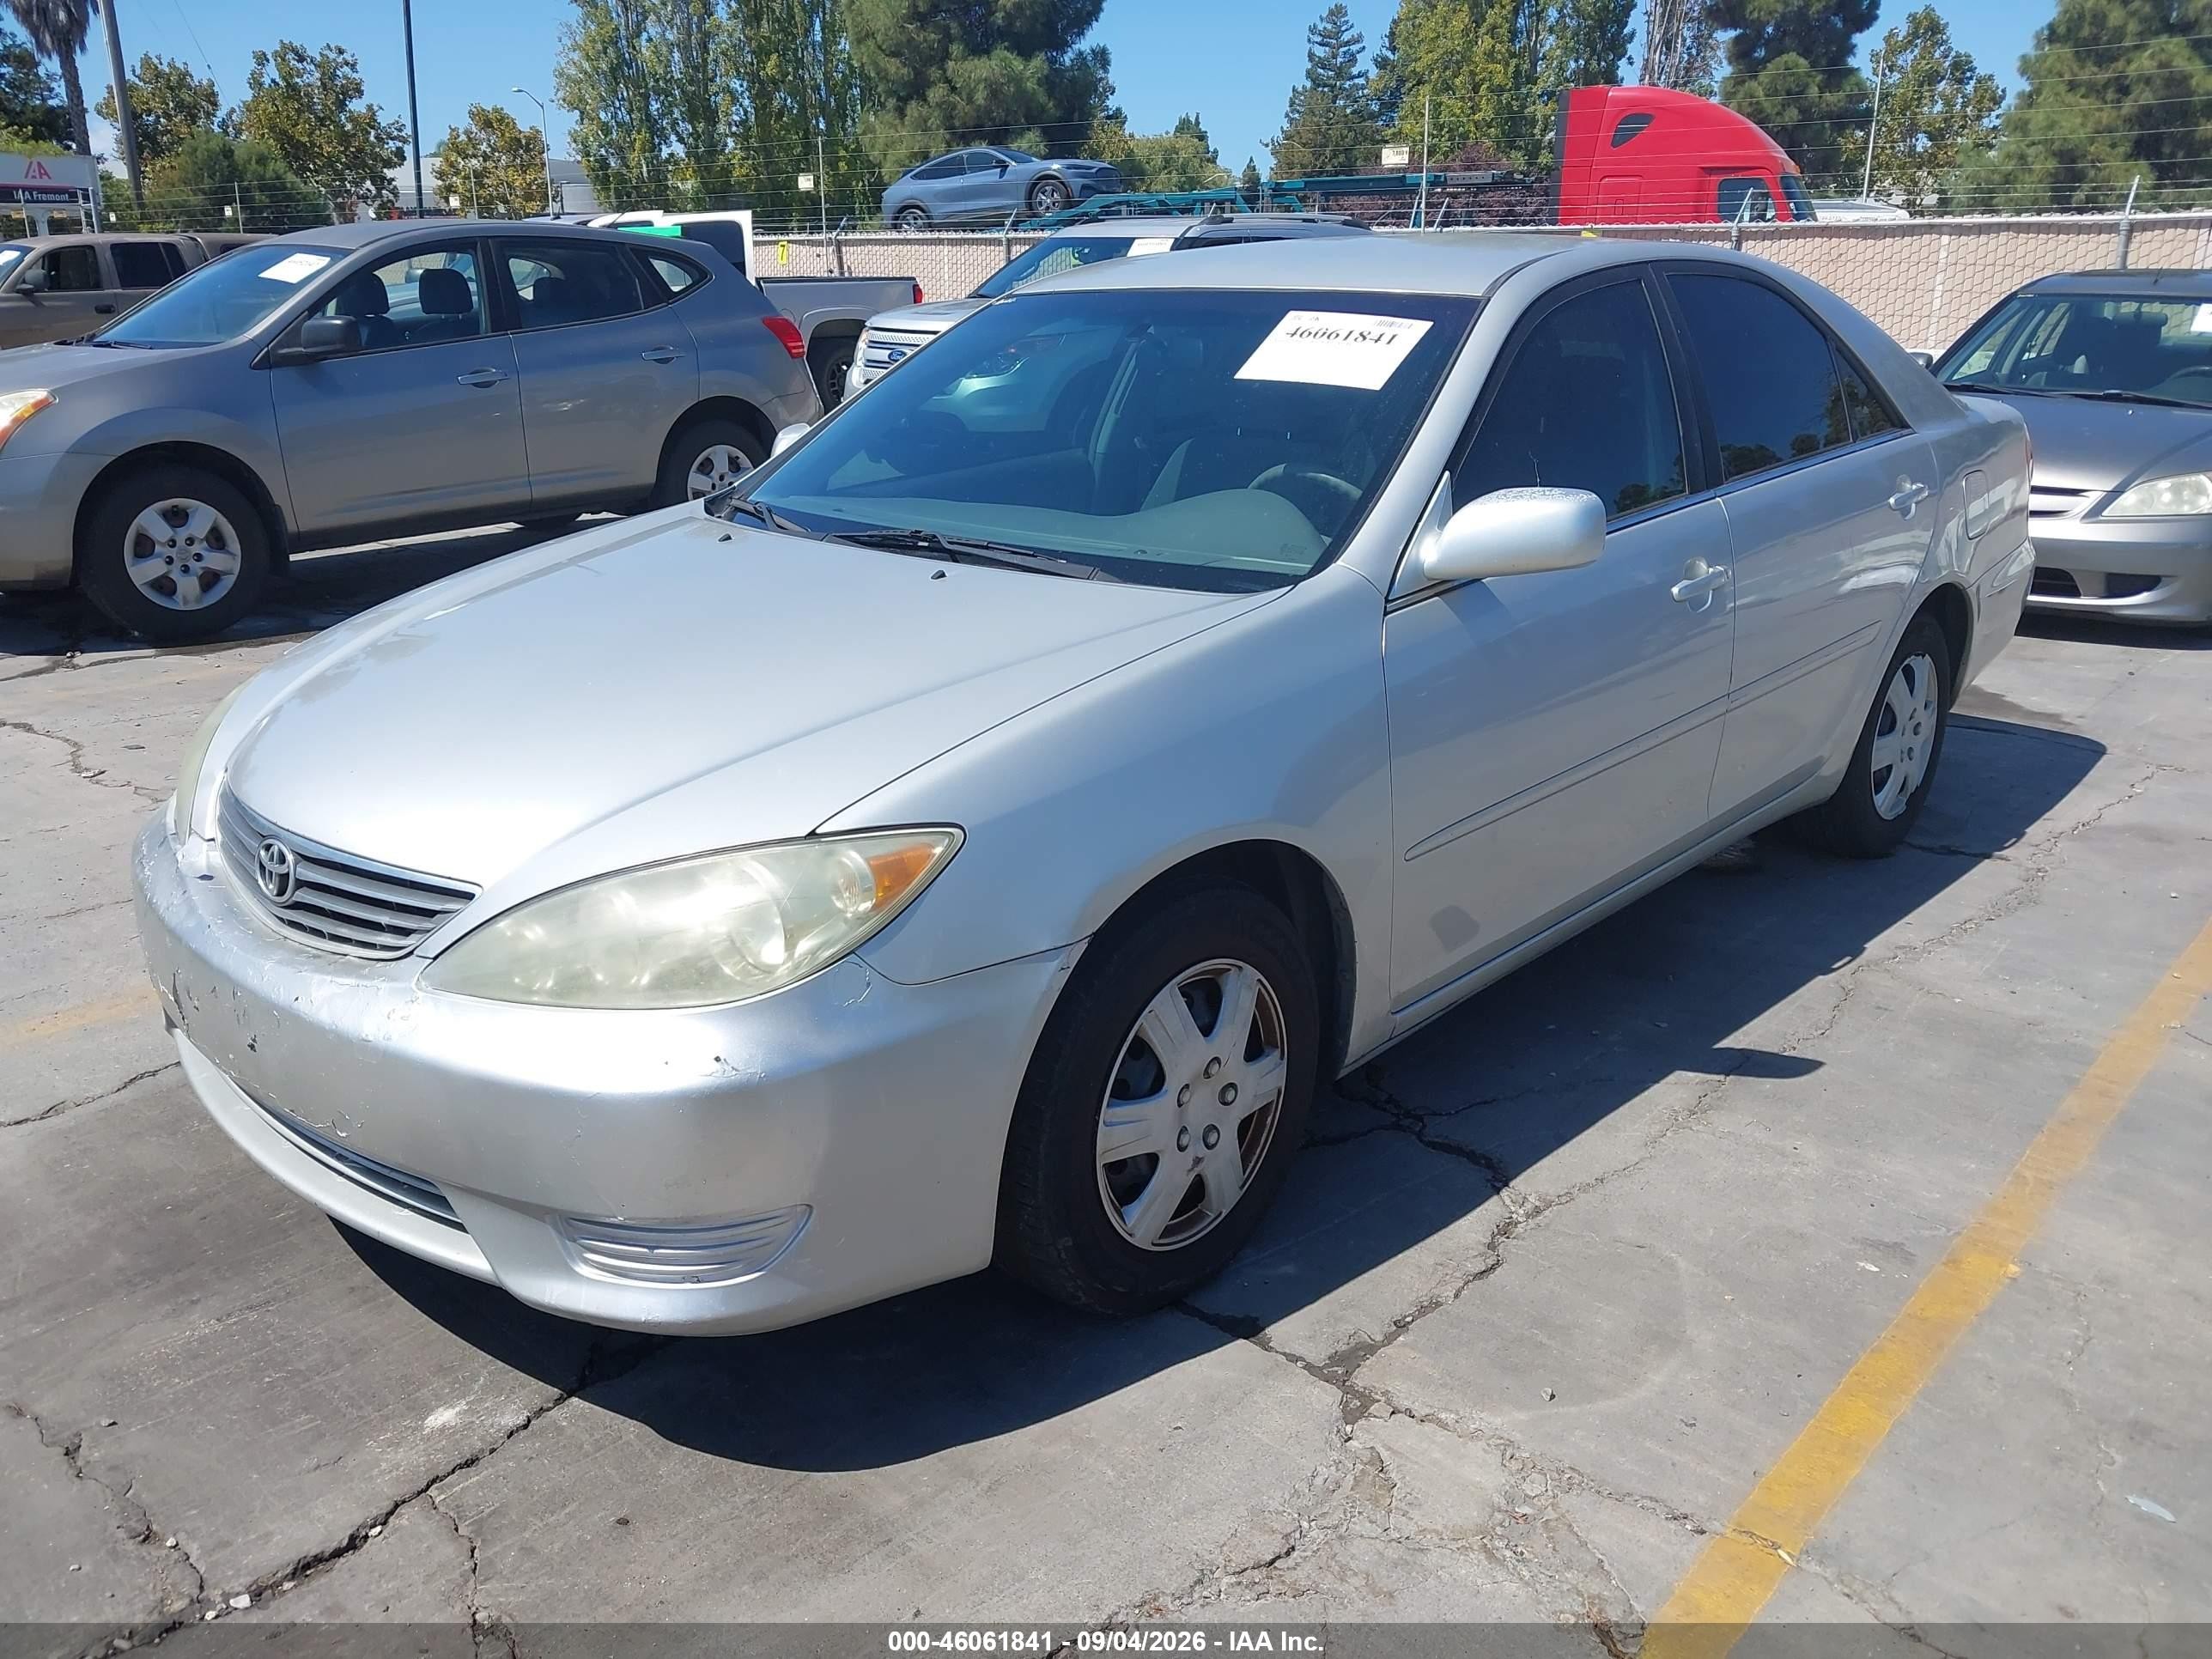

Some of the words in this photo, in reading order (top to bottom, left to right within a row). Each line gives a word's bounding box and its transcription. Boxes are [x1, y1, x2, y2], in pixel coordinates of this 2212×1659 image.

[33, 191, 69, 201] Fremont
[780, 244, 786, 261] 7
[1285, 325, 1399, 345] 46061841
[890, 351, 905, 361] Ford
